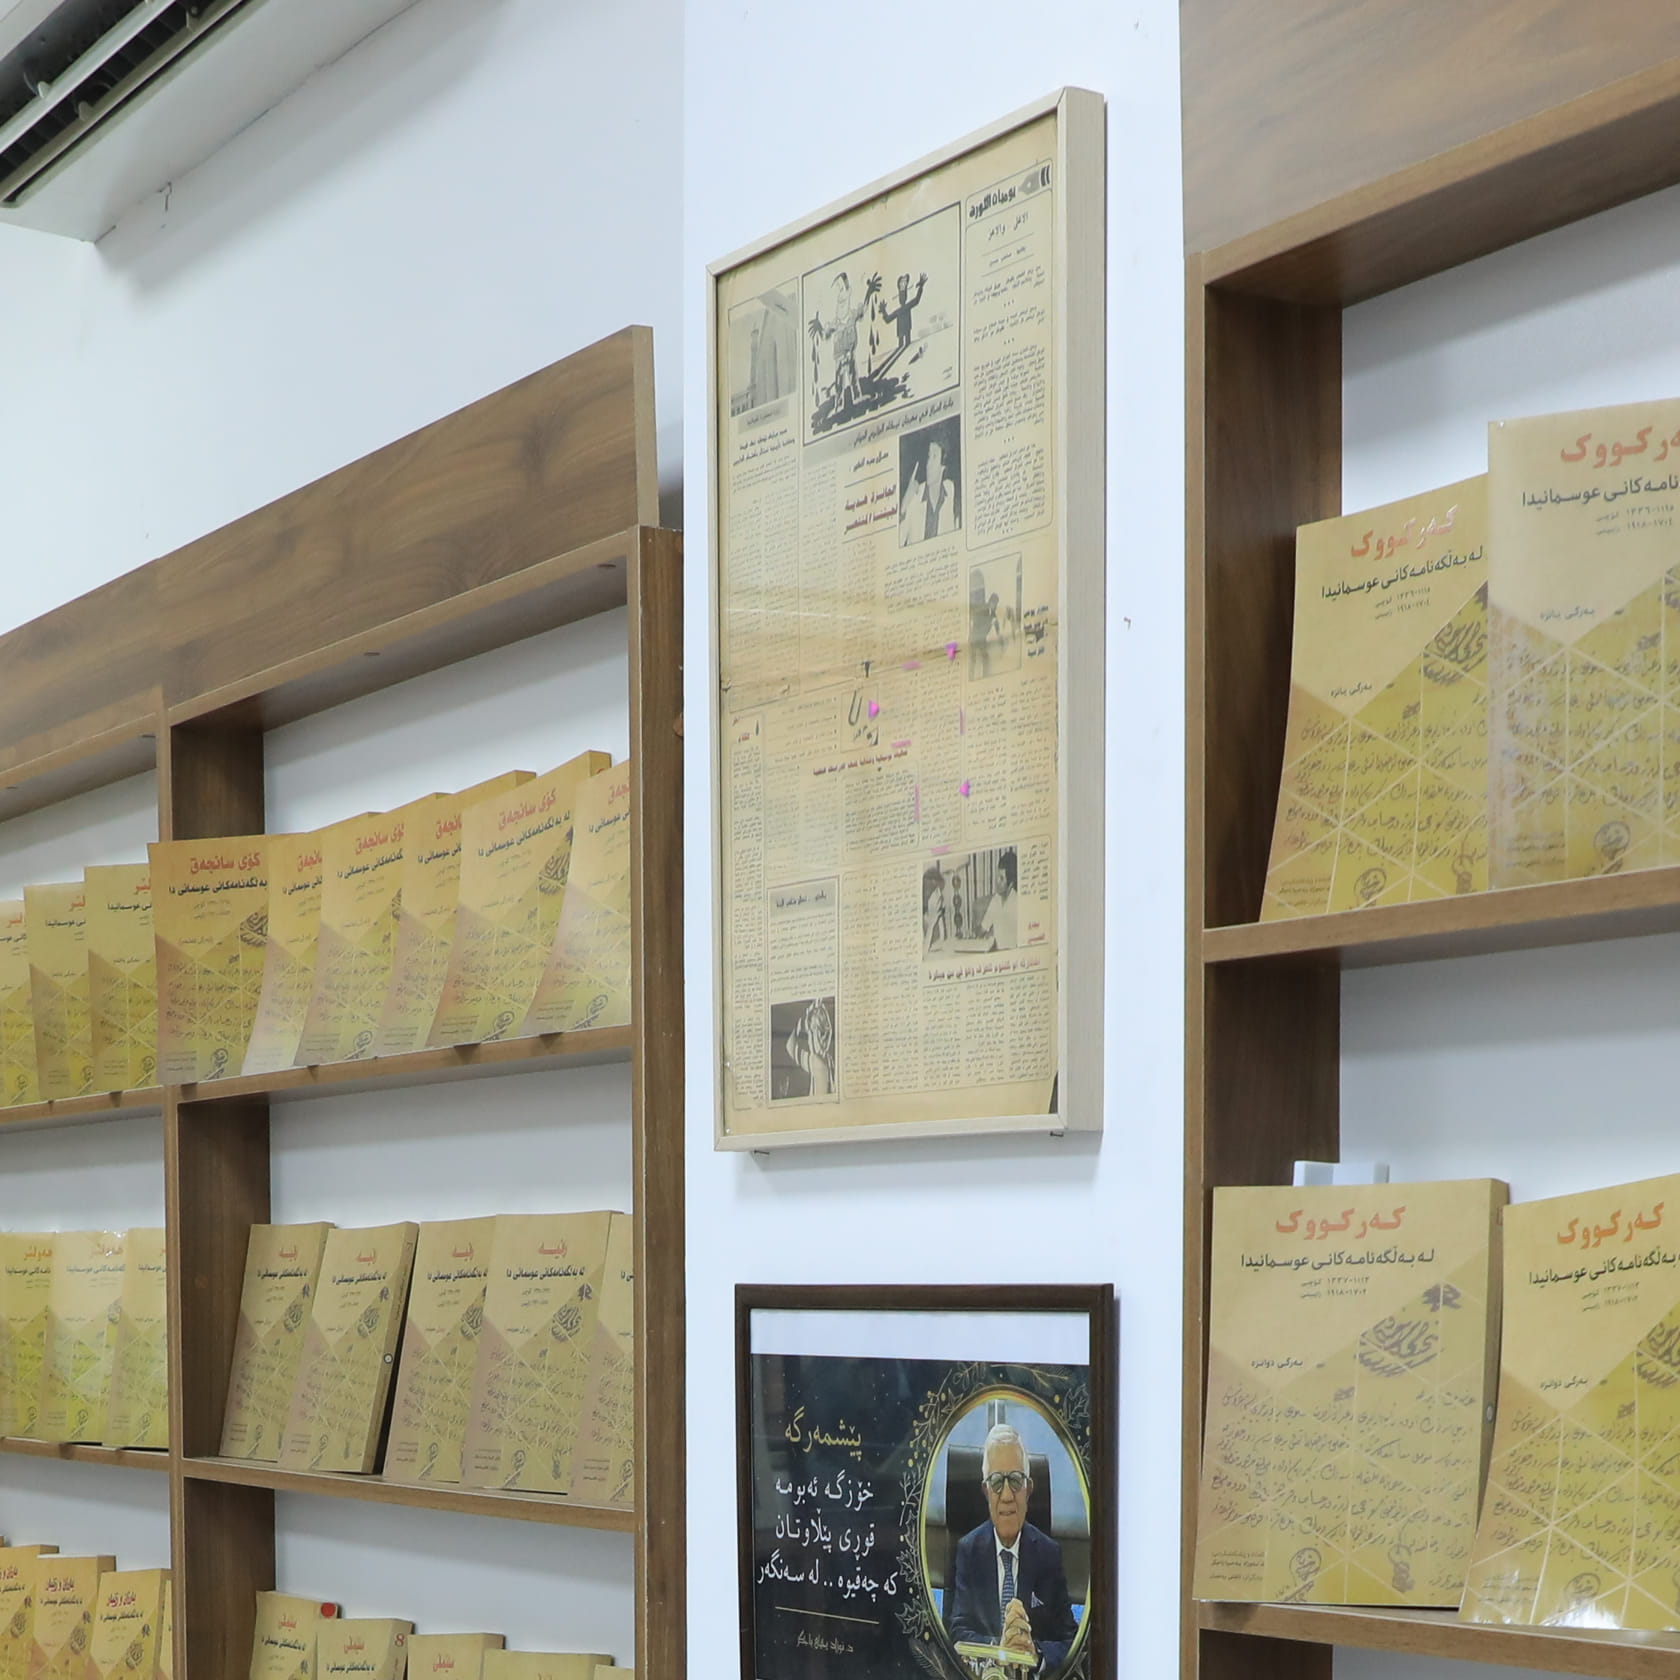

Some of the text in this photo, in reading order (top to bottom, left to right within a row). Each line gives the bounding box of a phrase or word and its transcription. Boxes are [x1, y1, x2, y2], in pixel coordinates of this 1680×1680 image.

[785, 1406, 862, 1461] پێشمەرگە
[824, 1469, 874, 1511] خۆزگە
[808, 1559, 819, 1584] لە
[884, 1571, 898, 1595] کە
